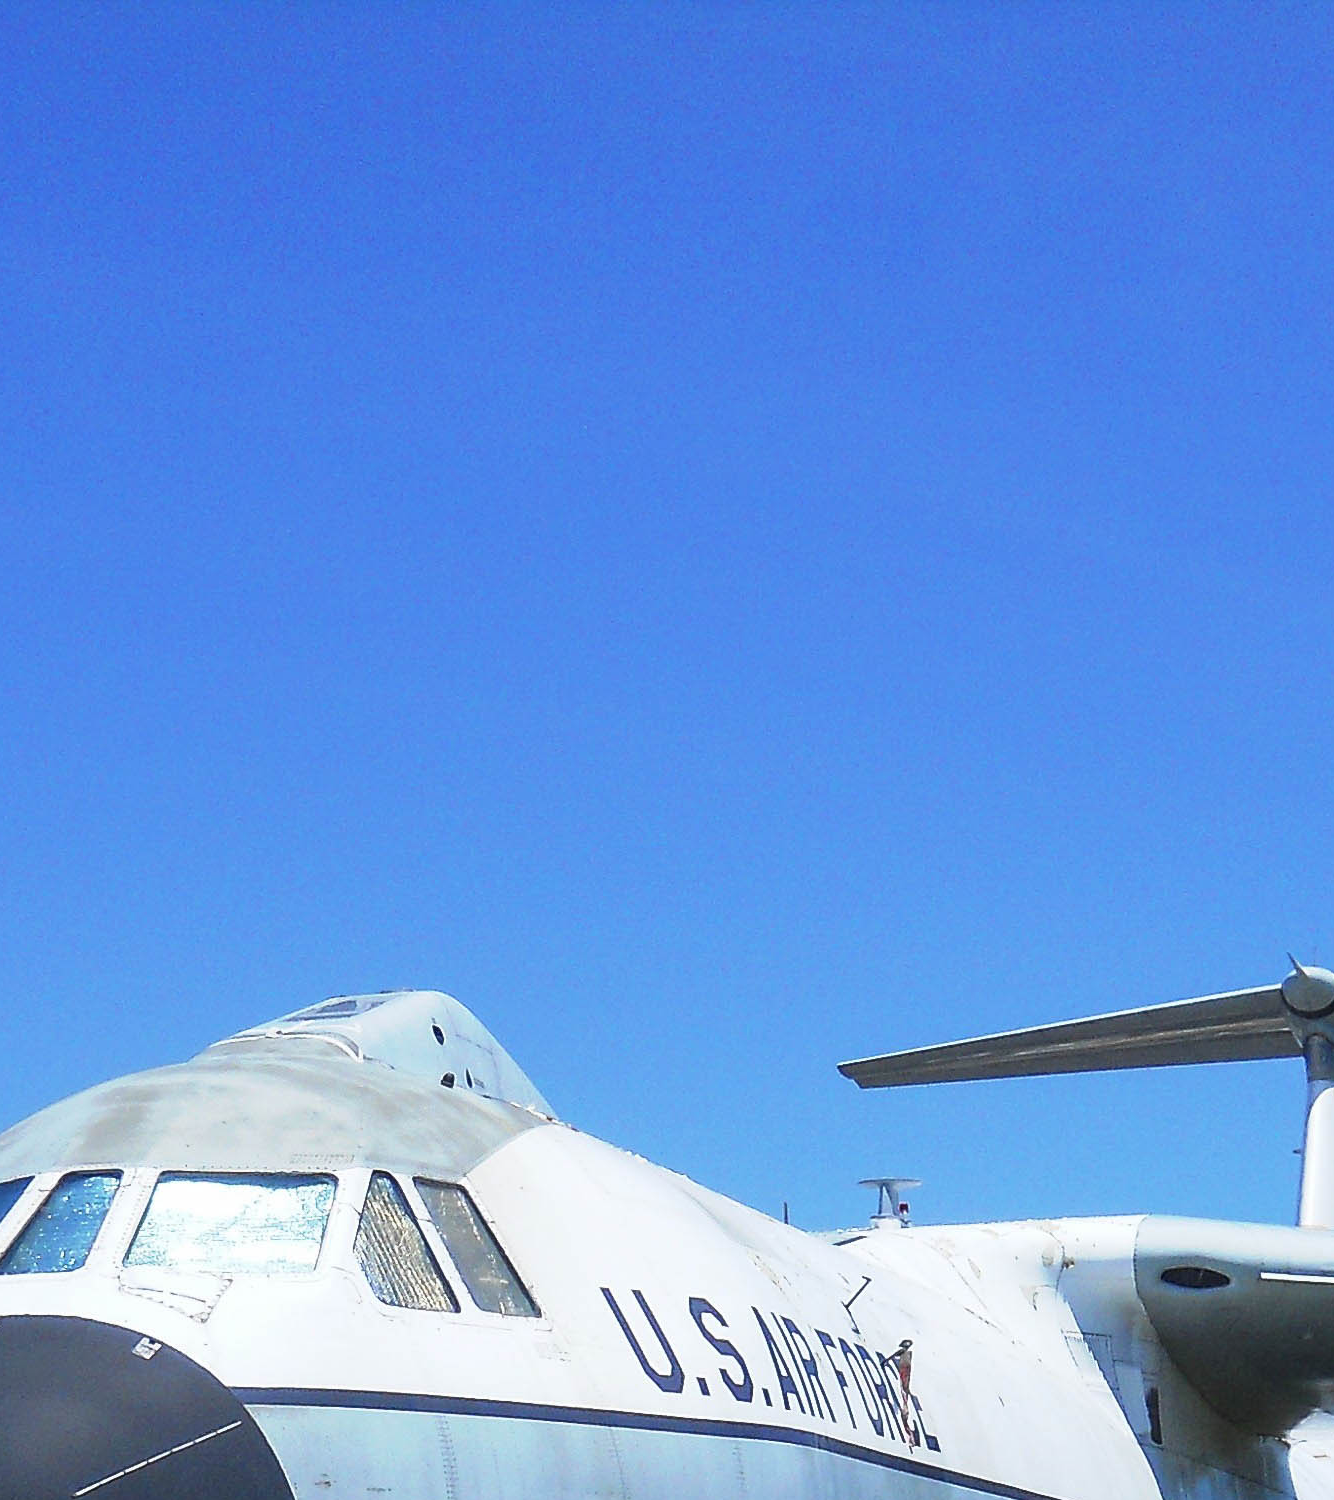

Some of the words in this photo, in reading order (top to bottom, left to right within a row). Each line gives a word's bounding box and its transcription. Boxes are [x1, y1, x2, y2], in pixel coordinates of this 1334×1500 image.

[599, 1286, 773, 1408] U.S.
[751, 1305, 837, 1424] AIR
[814, 1327, 942, 1453] FORCE
